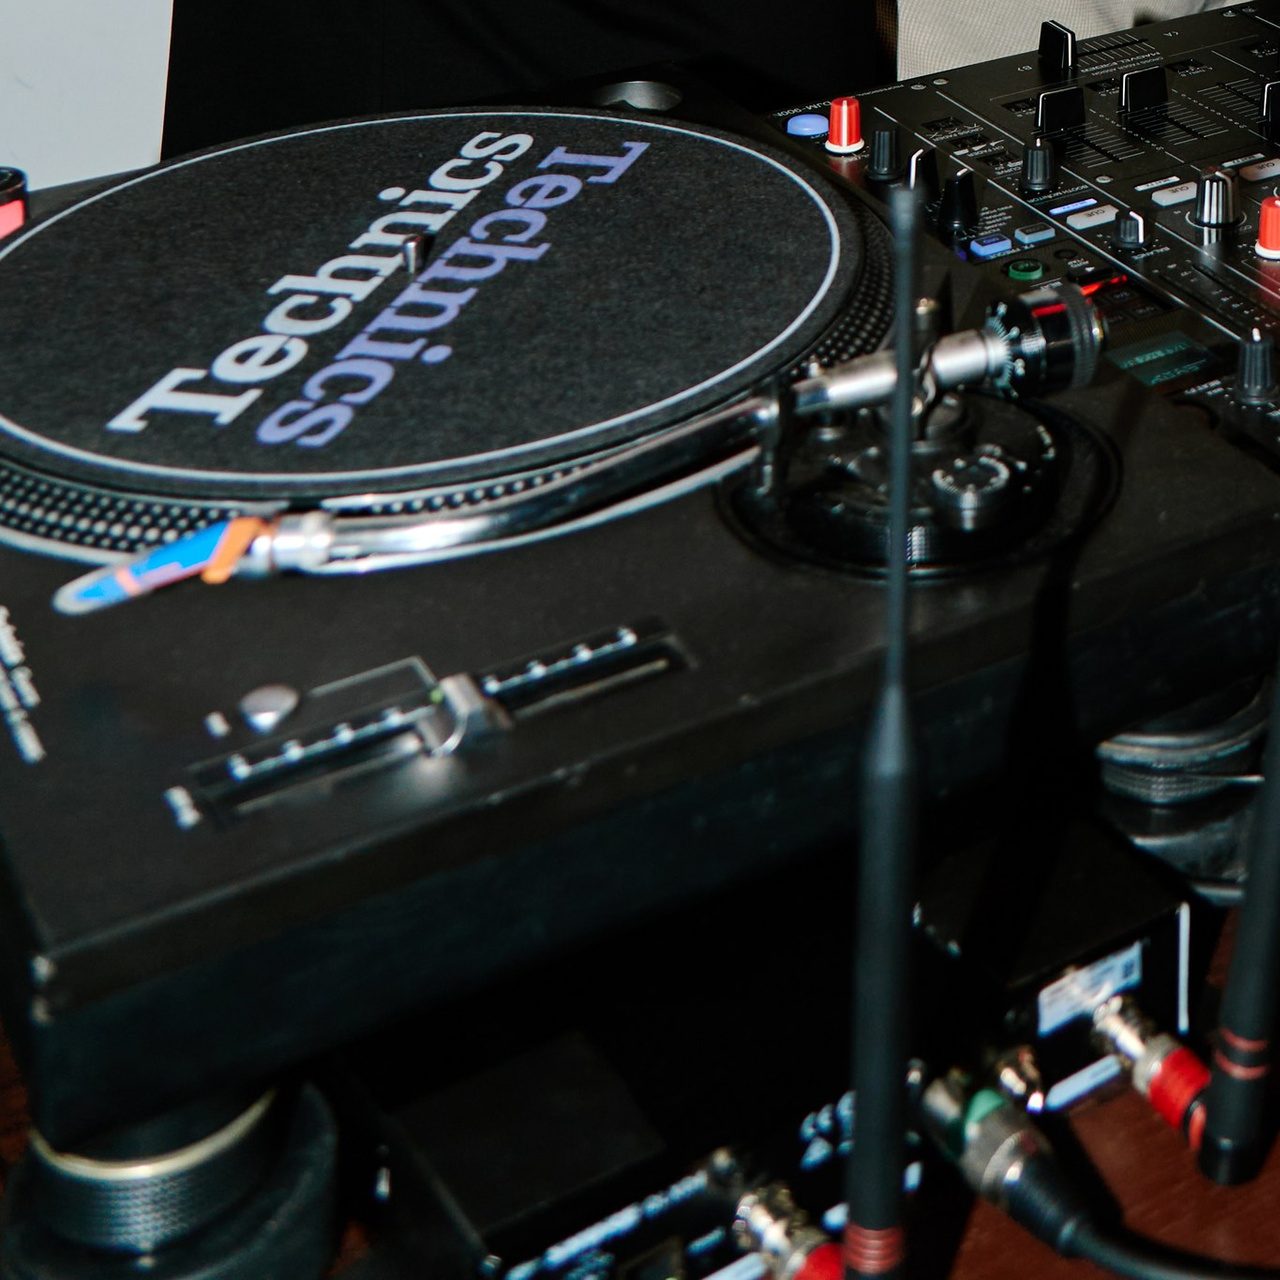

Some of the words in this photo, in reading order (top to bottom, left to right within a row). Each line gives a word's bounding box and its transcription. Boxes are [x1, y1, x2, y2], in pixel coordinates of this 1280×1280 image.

[1256, 161, 1275, 170] CUE
[1169, 186, 1189, 194] CUE
[1085, 209, 1105, 218] CUE
[105, 130, 536, 434] Technics
[256, 138, 650, 449] Technics
